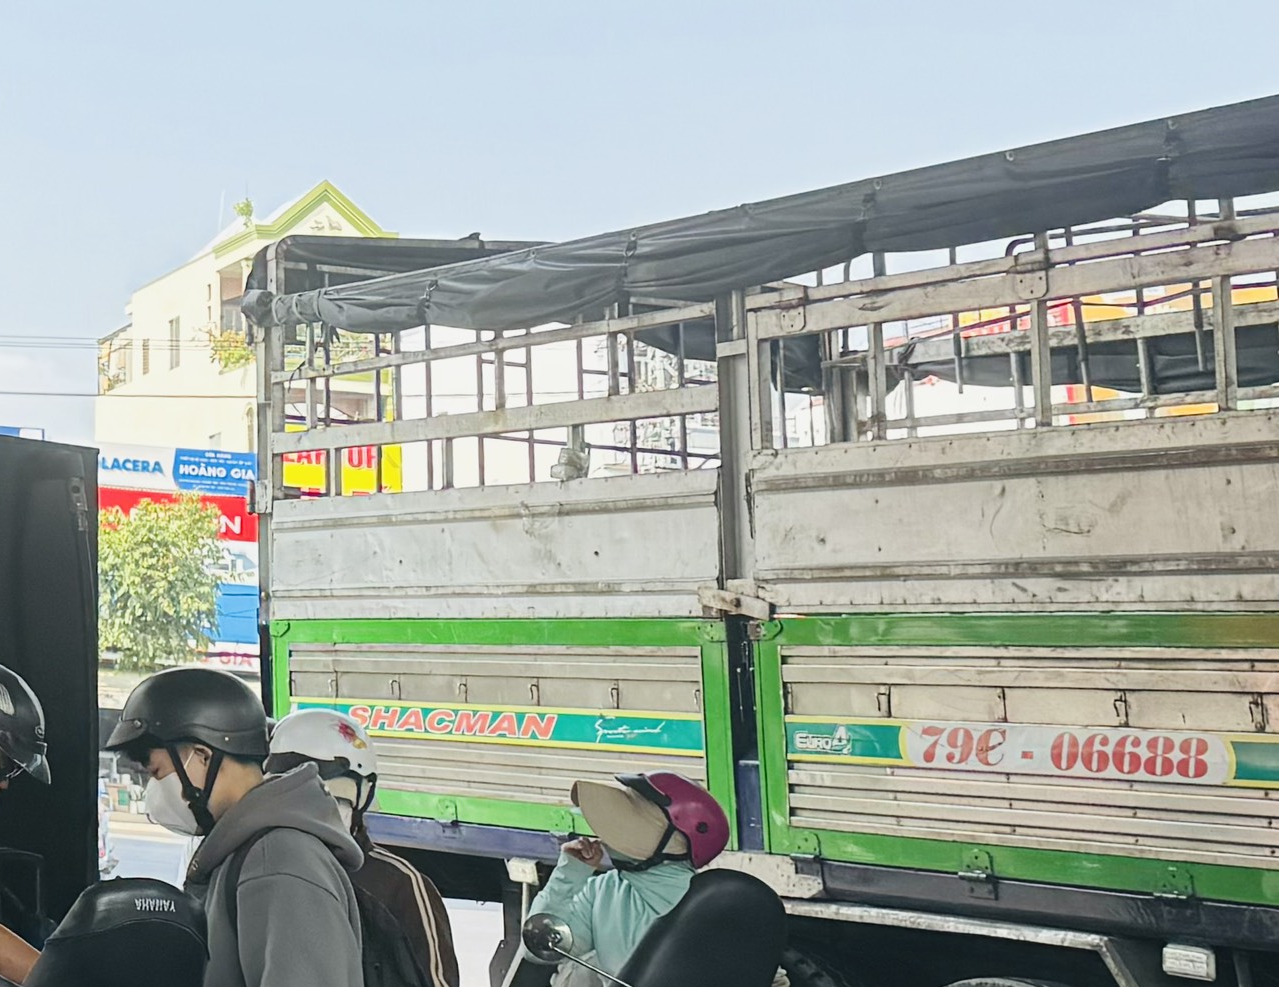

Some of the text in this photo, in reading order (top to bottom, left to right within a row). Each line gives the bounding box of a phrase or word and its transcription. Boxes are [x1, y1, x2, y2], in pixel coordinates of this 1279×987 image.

[179, 463, 255, 480] HOÀNG GIA
[348, 706, 558, 740] SHACMAN
[1050, 731, 1209, 778] 06688
[134, 898, 176, 912] YAMAHA
